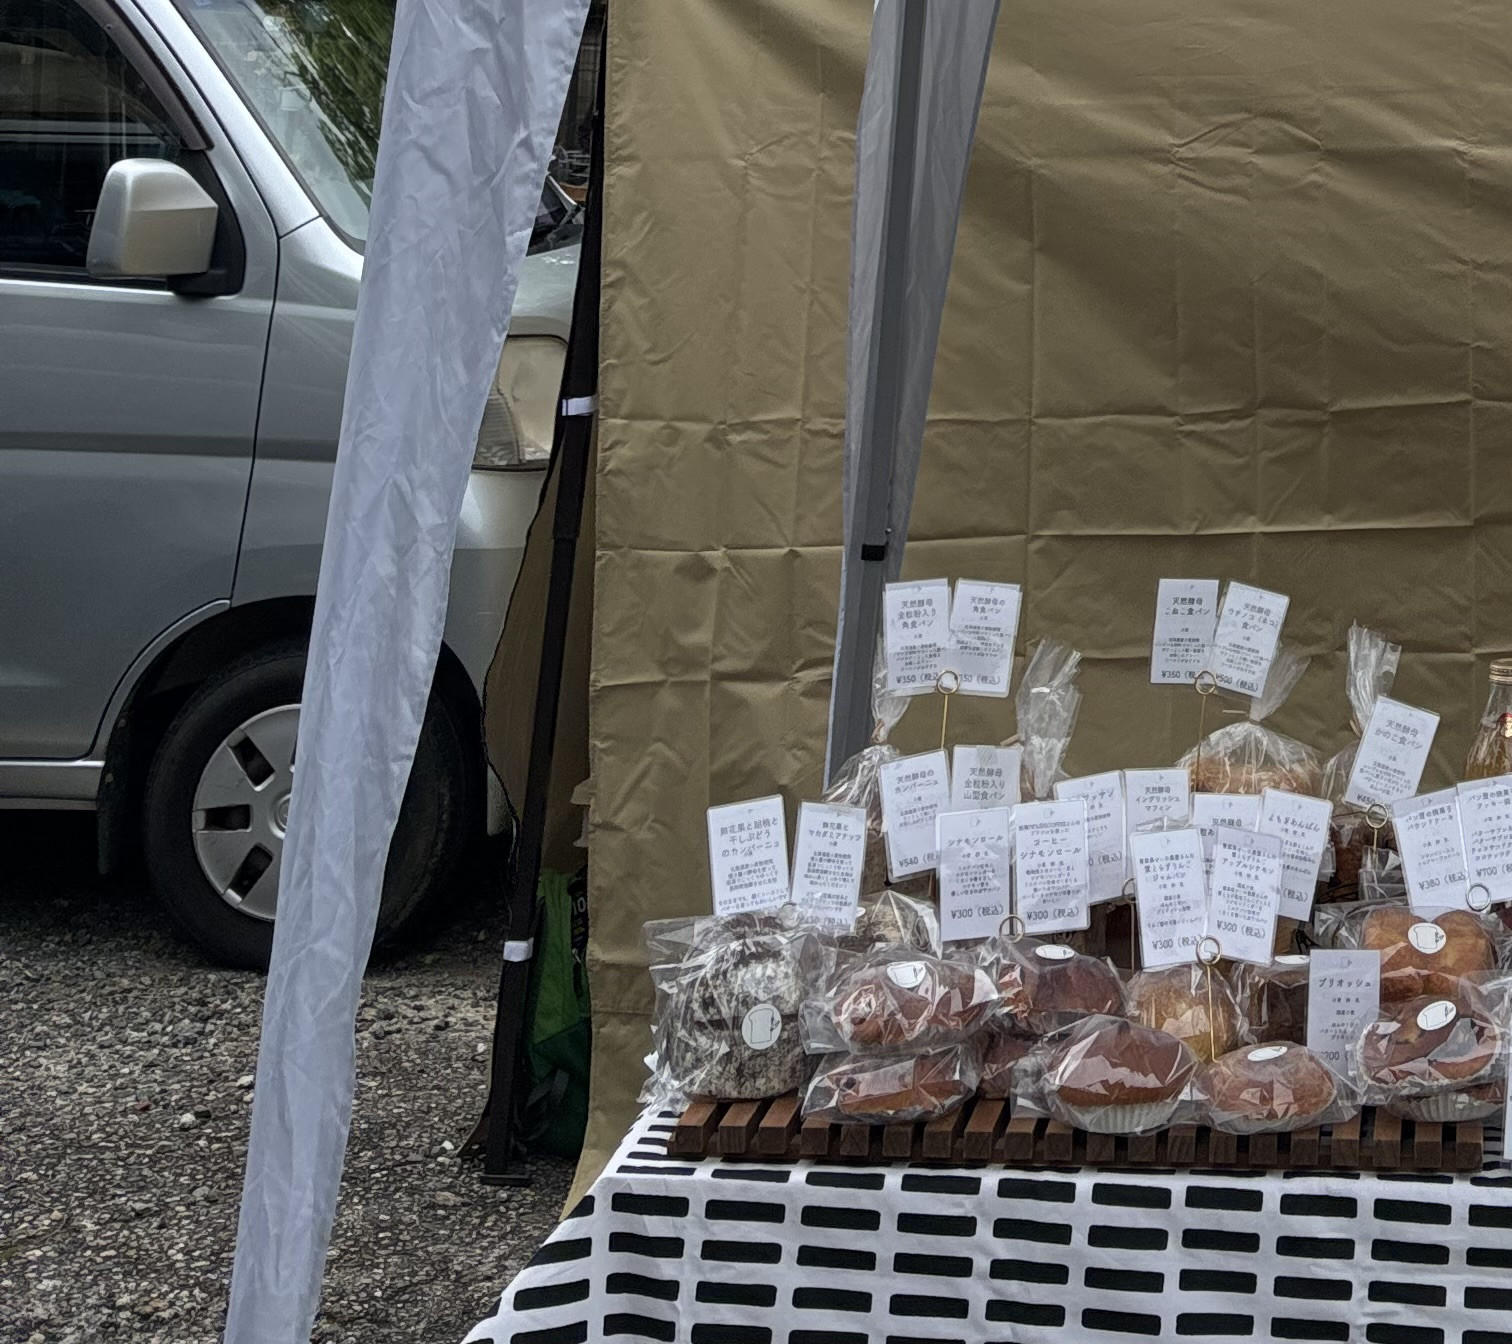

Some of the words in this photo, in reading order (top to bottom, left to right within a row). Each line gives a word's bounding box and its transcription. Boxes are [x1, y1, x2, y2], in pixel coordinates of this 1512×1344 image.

[901, 598, 933, 609] 天然酵母
[1172, 597, 1203, 606] 天然酵母
[1386, 719, 1419, 738] 天然酵母
[969, 768, 1003, 778] 天然酵母
[964, 791, 1005, 800] 山型食パン
[948, 835, 1004, 847] シナモンロール
[1034, 837, 1067, 846] コーヒー
[1020, 847, 1082, 860] シナモンロール
[1319, 978, 1371, 987] ブリオッシュ
